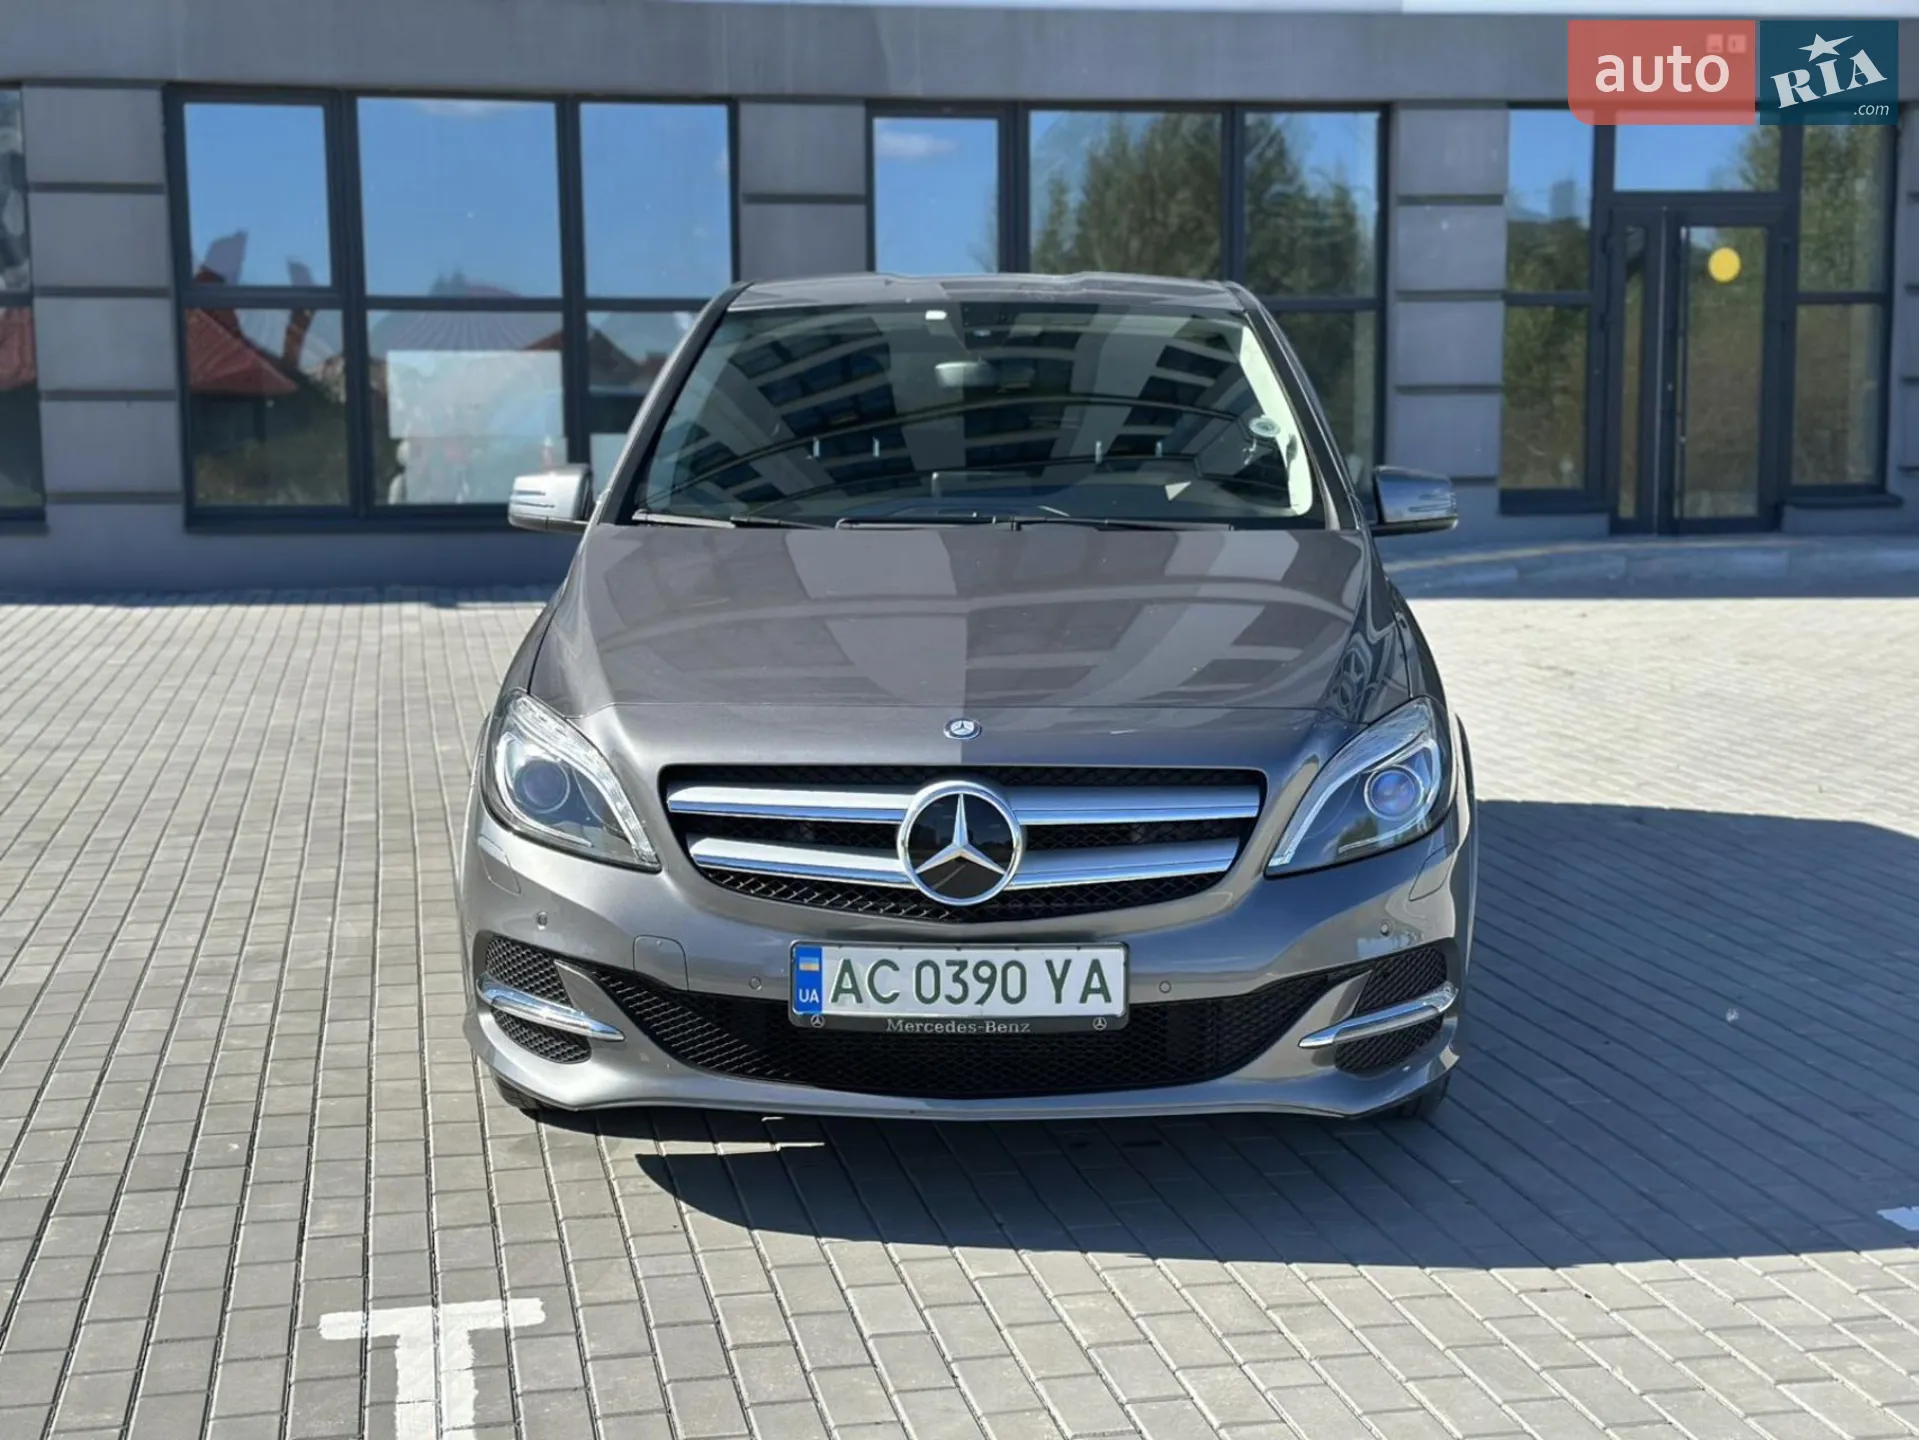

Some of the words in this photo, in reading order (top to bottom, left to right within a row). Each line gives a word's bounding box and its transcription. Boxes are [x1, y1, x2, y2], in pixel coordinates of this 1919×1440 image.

[830, 958, 900, 1005] AC
[914, 959, 1028, 1006] 0390
[1045, 958, 1113, 1005] YA
[798, 988, 819, 1004] UA
[885, 1018, 1031, 1034] Mercedes-Benz
